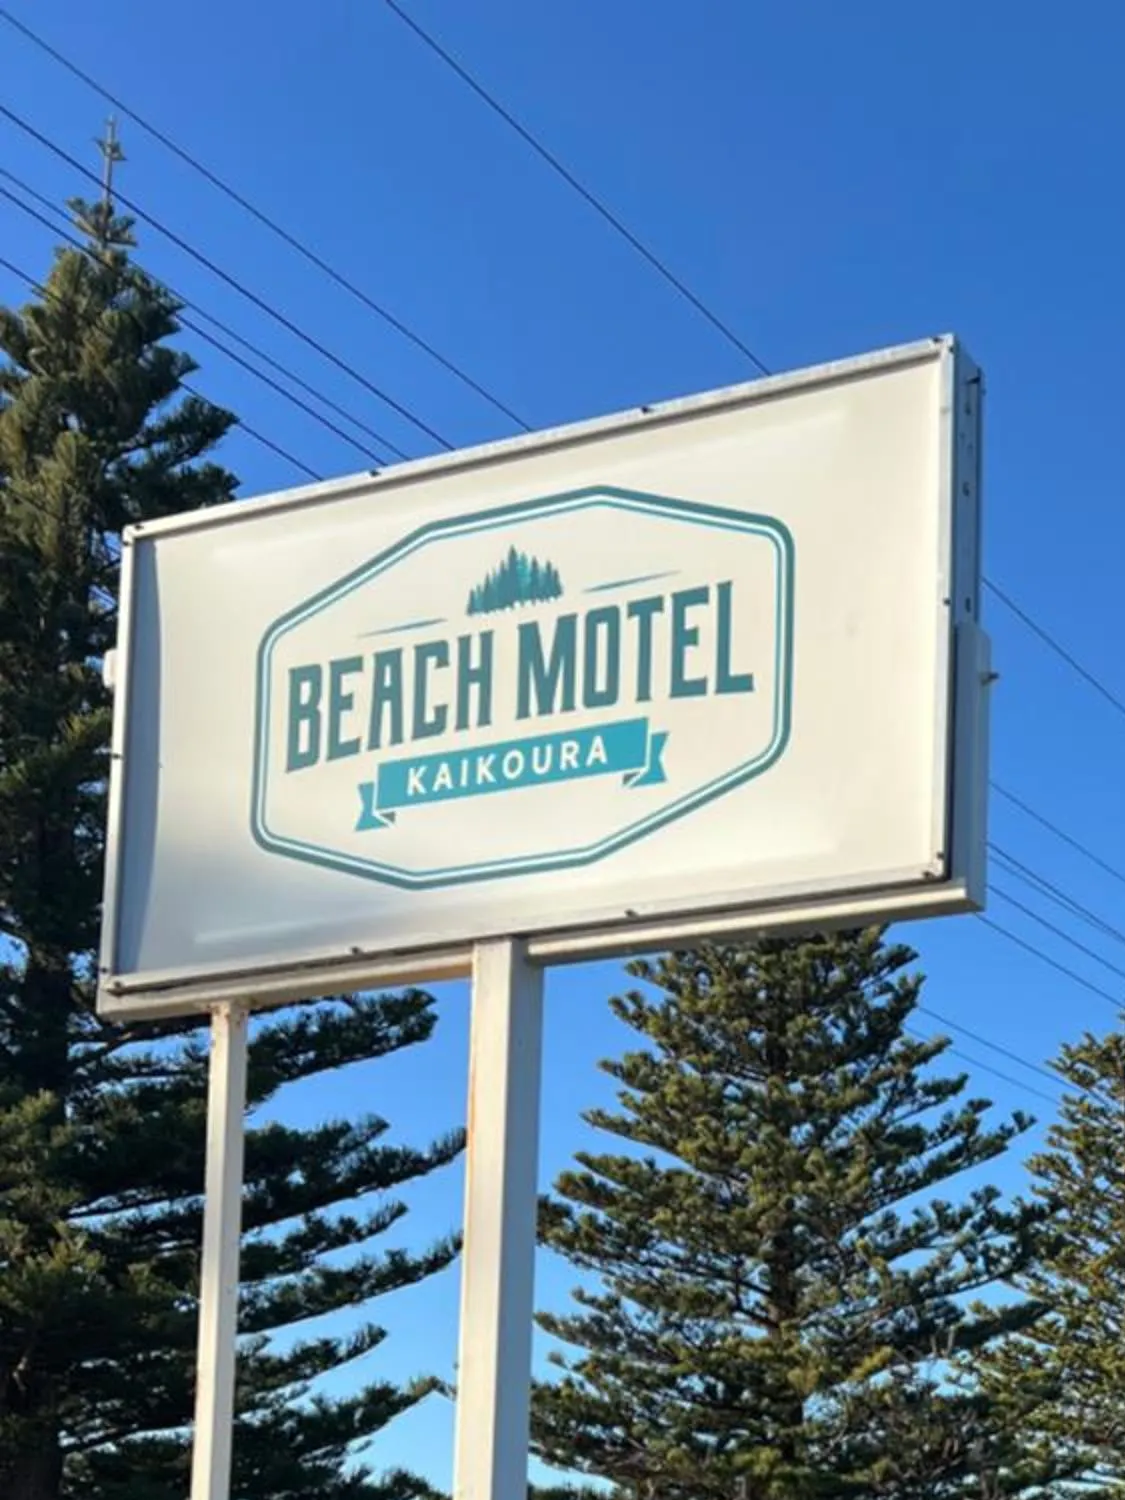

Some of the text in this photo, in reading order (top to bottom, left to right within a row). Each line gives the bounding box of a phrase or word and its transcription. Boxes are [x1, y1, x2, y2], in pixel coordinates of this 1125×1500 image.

[285, 580, 755, 773] BEACH MOTEL
[406, 735, 609, 796] KAIKOURA
